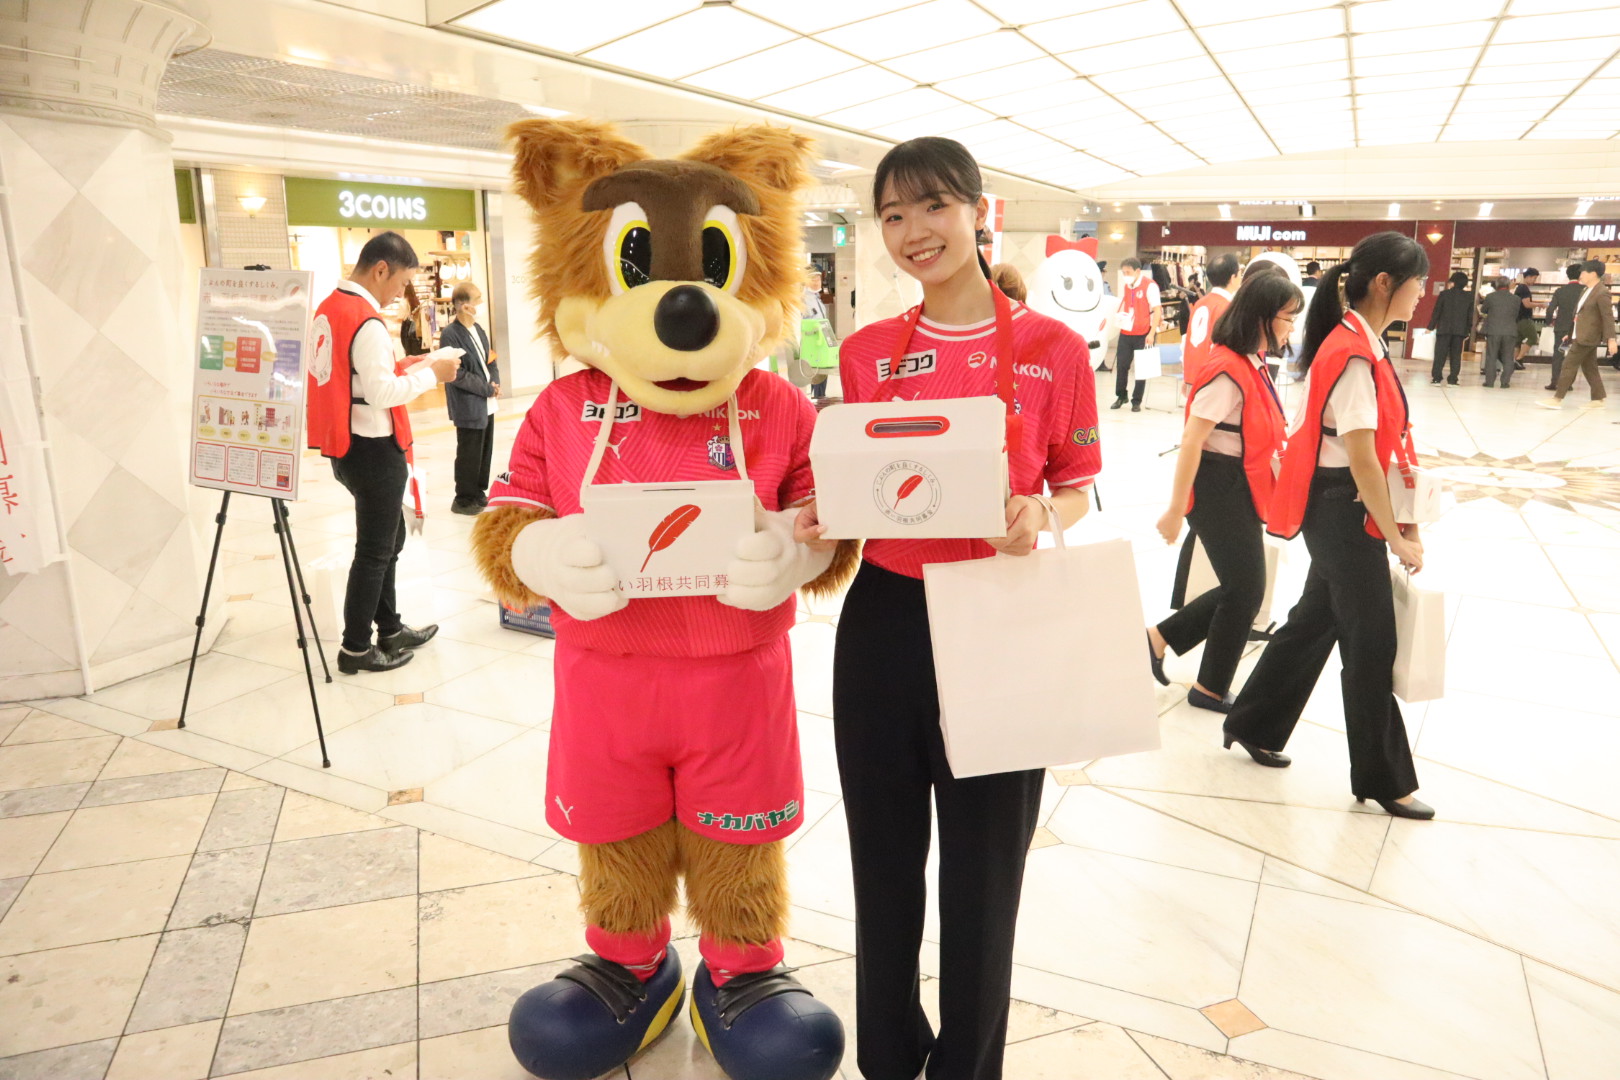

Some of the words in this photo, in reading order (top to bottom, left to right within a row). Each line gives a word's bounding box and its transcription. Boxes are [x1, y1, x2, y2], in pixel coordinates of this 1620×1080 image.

[339, 191, 427, 220] 3COINS
[1237, 226, 1271, 241] MUJI
[1272, 231, 1306, 241] com
[1573, 225, 1616, 241] MUJI
[698, 407, 760, 421] NIKON
[611, 574, 729, 592] い羽根共同募
[697, 799, 799, 831] ナカバヤシ
